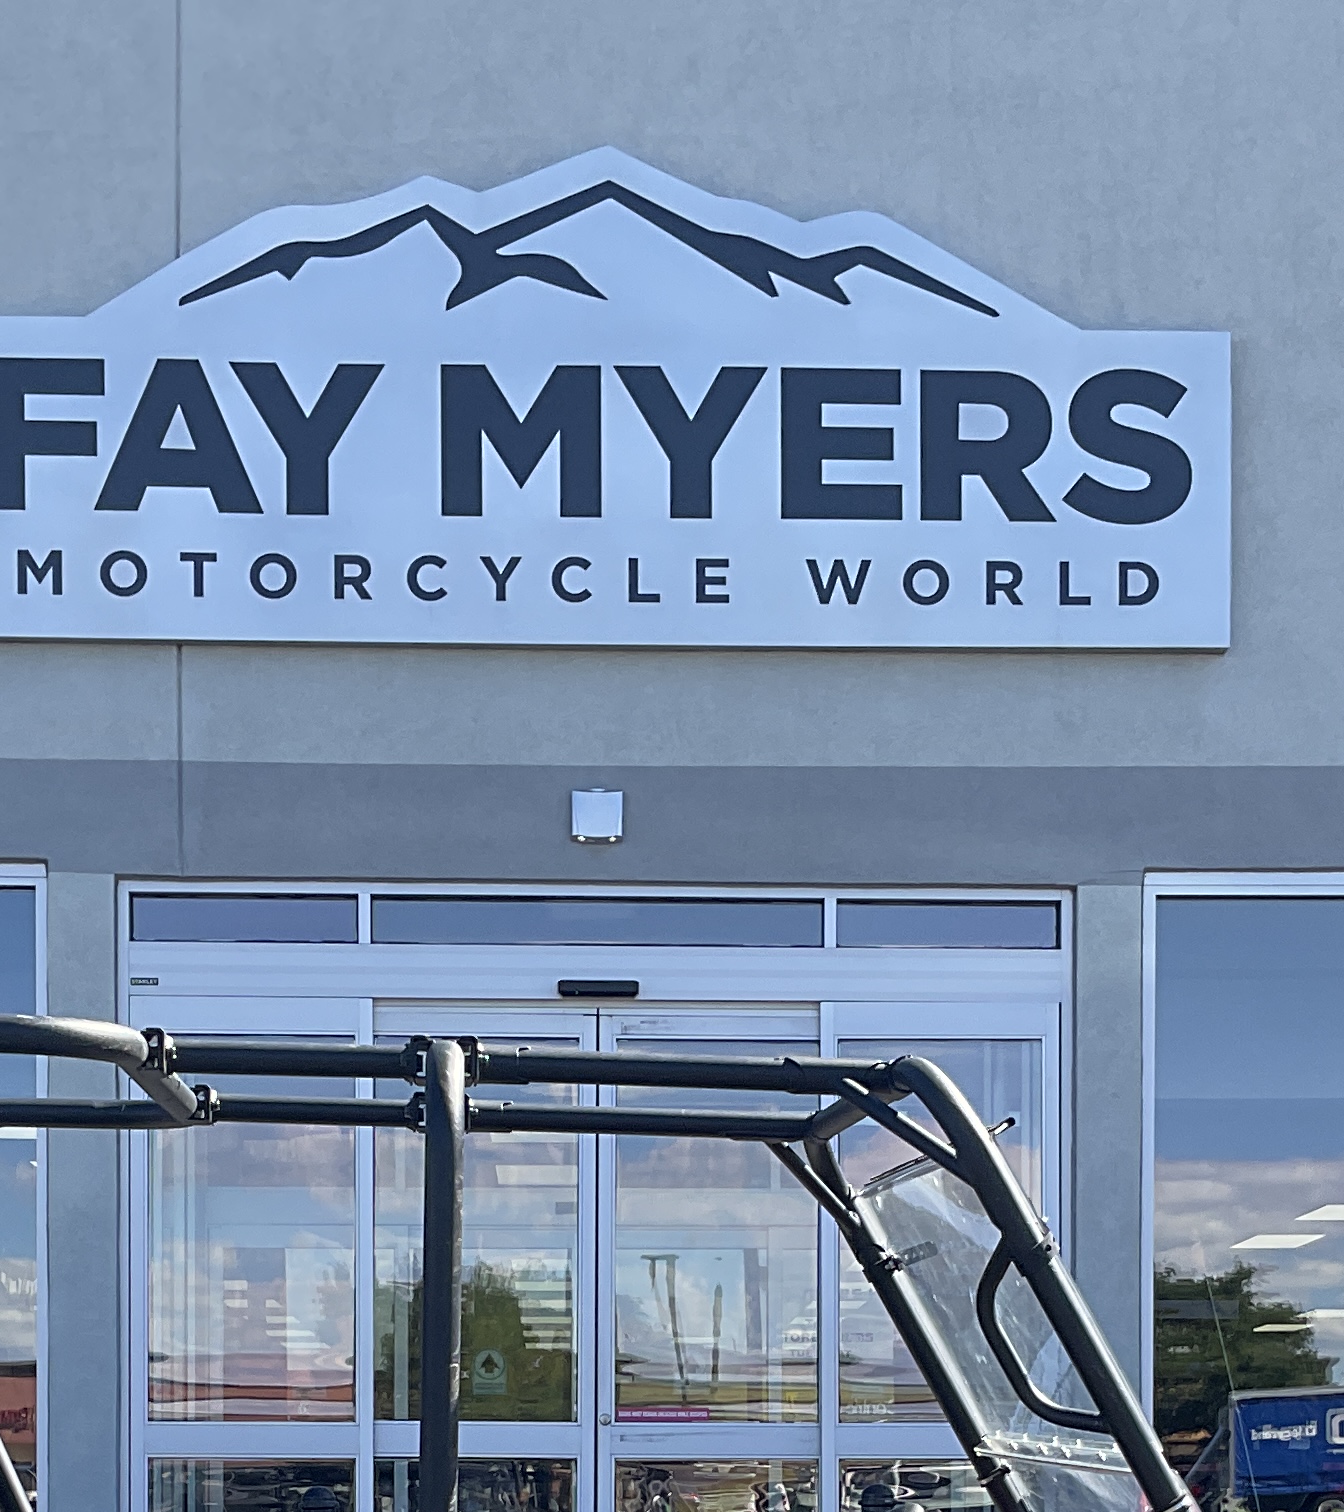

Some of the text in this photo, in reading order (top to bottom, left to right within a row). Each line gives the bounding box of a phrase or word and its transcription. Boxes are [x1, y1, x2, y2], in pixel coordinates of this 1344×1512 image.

[440, 364, 1193, 525] MYERS
[16, 548, 1161, 607] MOTORCYCLE WORLD
